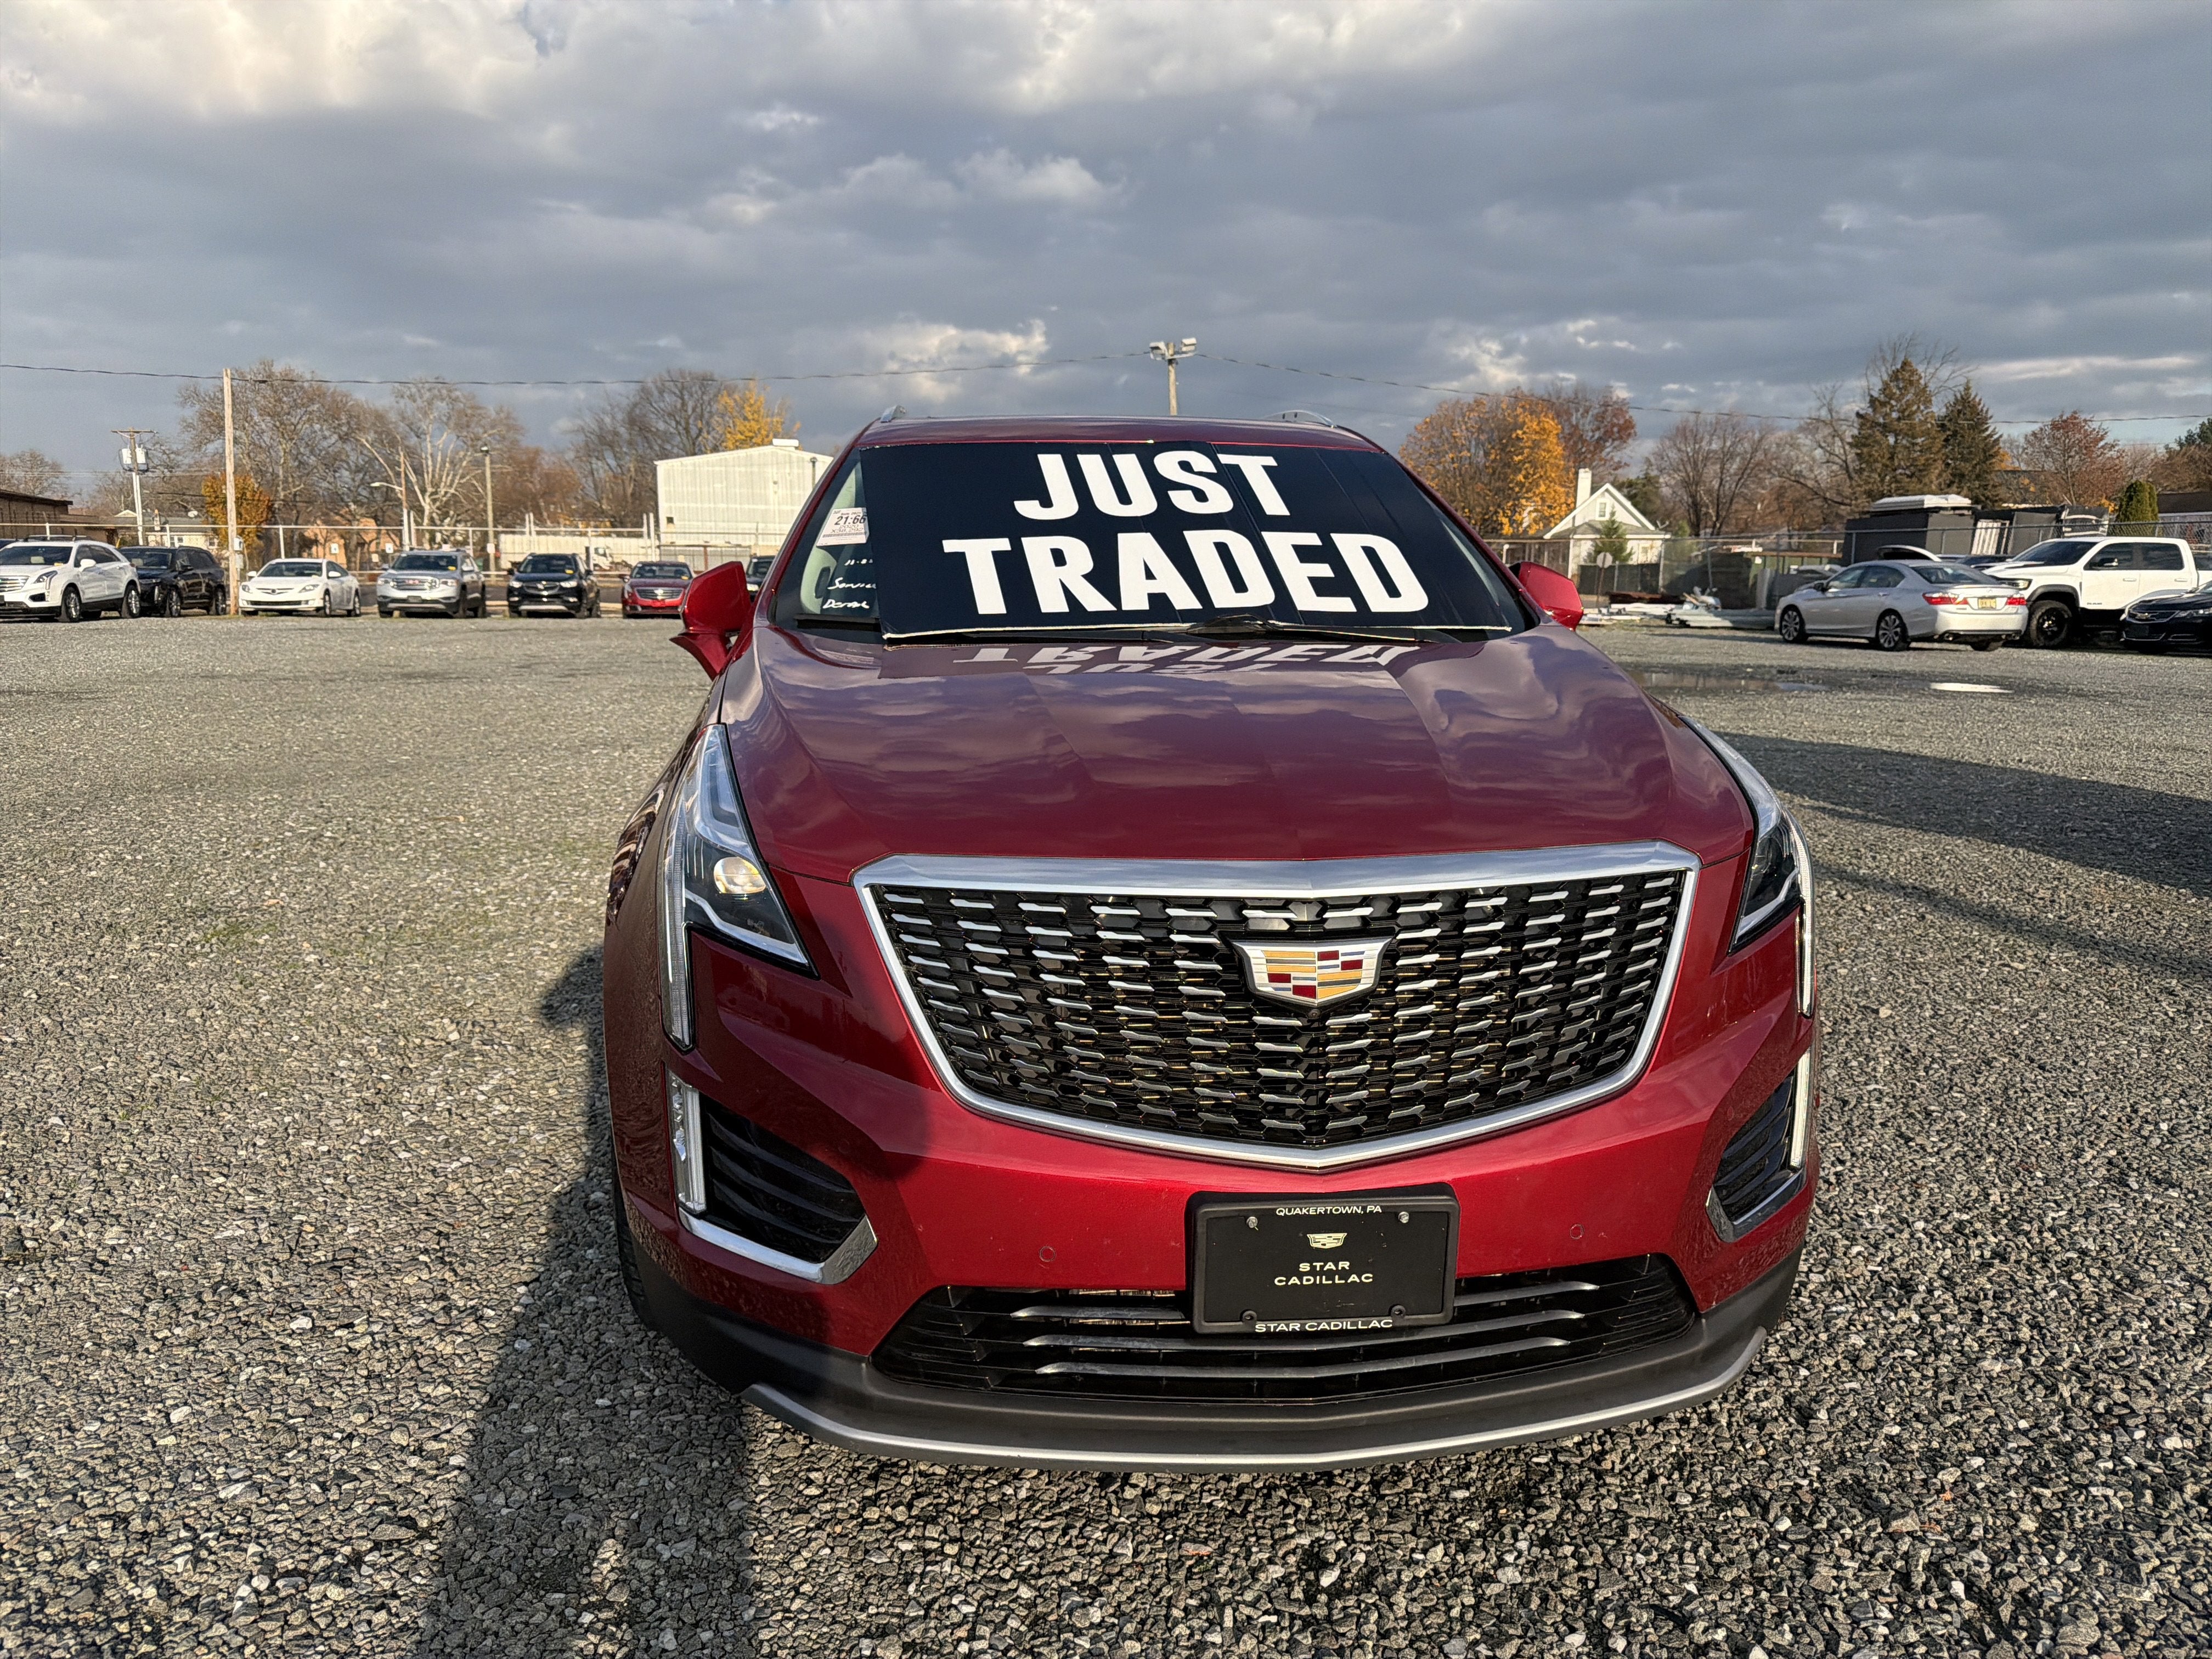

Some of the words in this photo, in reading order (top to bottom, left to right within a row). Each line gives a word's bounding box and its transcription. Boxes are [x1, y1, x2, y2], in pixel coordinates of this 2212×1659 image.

[1013, 450, 1290, 520] JUST
[942, 529, 1429, 614] TRADED
[1276, 1206, 1364, 1216] QUAKERTOWN,
[1299, 1261, 1350, 1272] STAR
[1274, 1273, 1373, 1286] CADILLAC
[1255, 1323, 1301, 1333] STAR
[1305, 1319, 1393, 1331] CADILLAC
